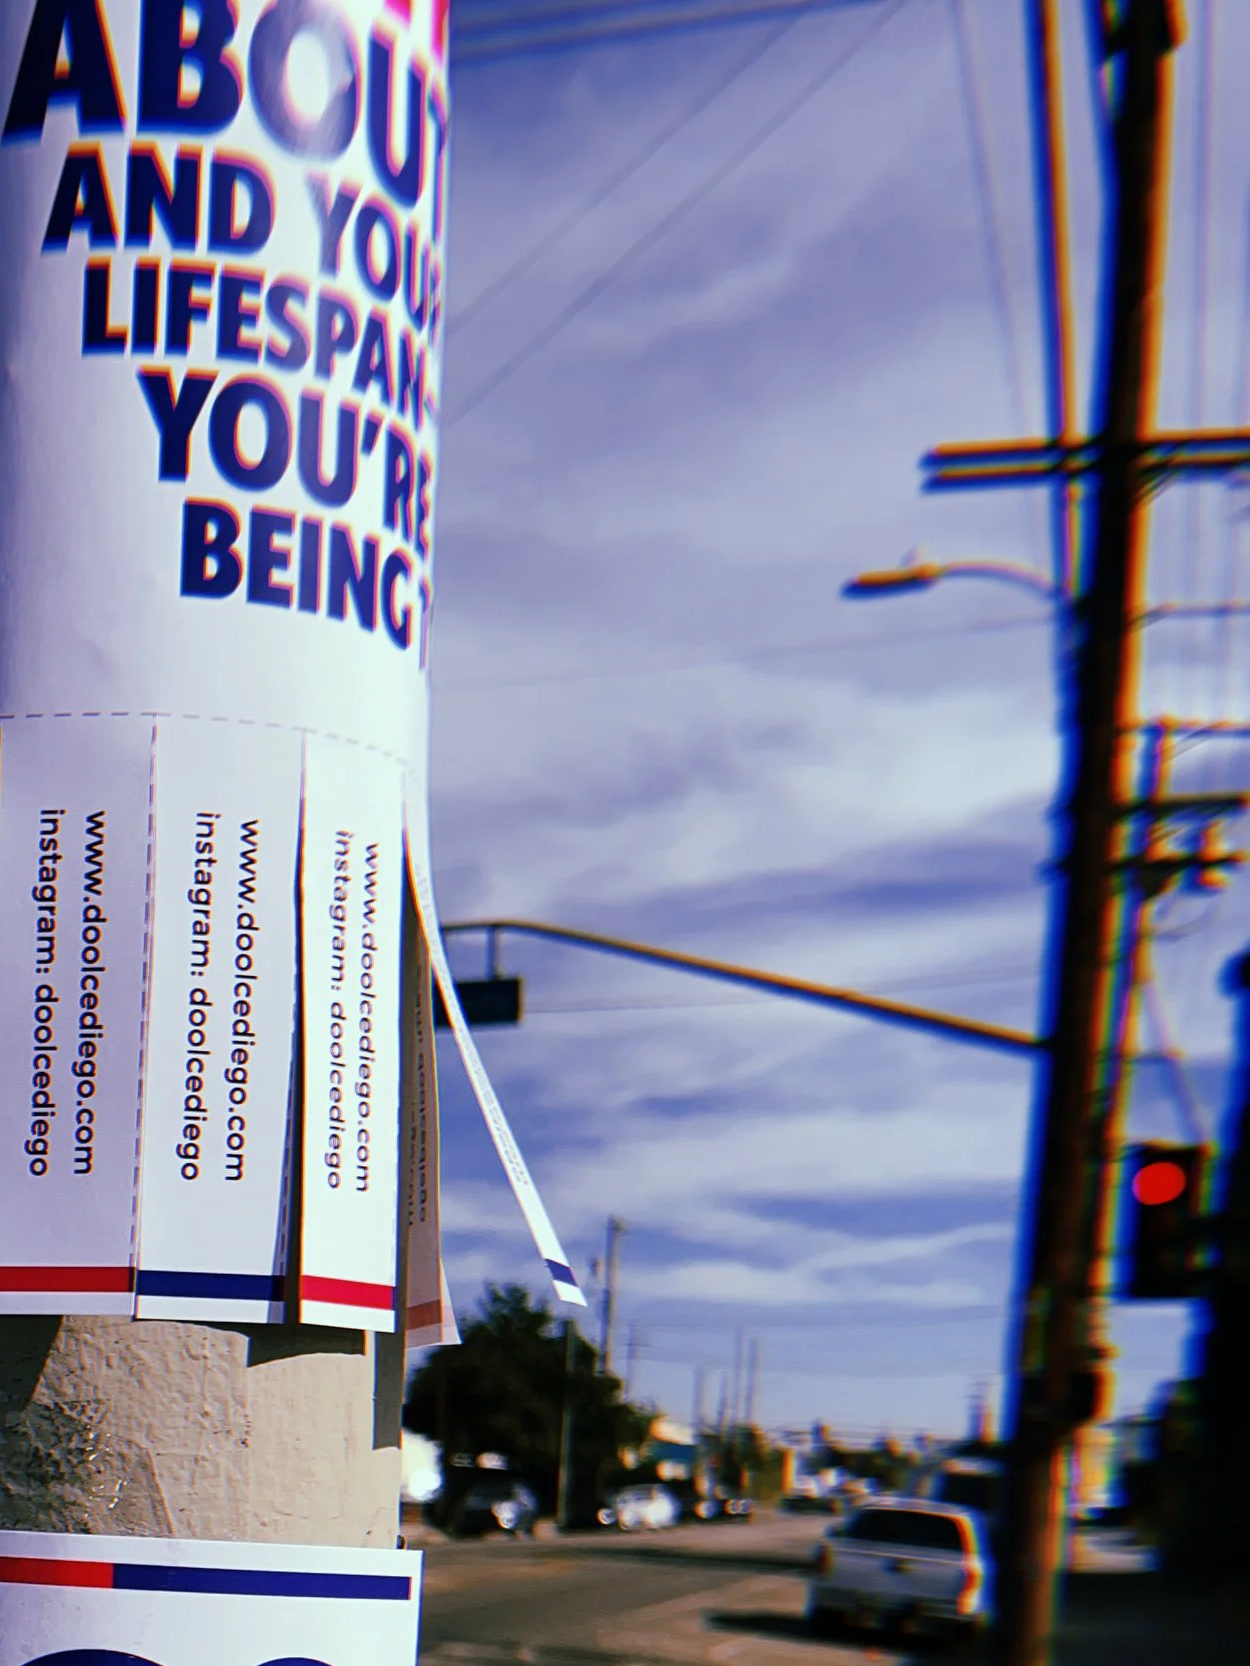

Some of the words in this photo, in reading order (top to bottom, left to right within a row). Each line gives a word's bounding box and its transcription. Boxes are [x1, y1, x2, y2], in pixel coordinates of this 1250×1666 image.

[42, 142, 274, 254] AND
[136, 366, 433, 562] YOU'RE
[31, 809, 66, 974] instagram:
[187, 812, 221, 977] instagram:
[328, 830, 353, 991] instagram:
[23, 984, 59, 1177] doolcediego
[71, 810, 108, 1175] www.doolcediego.com
[175, 987, 213, 1181] doolcediego
[223, 819, 260, 1181] www.doolcediego.com
[354, 843, 378, 1192] www.doolcediego.com
[324, 1001, 347, 1189] doolcediego
